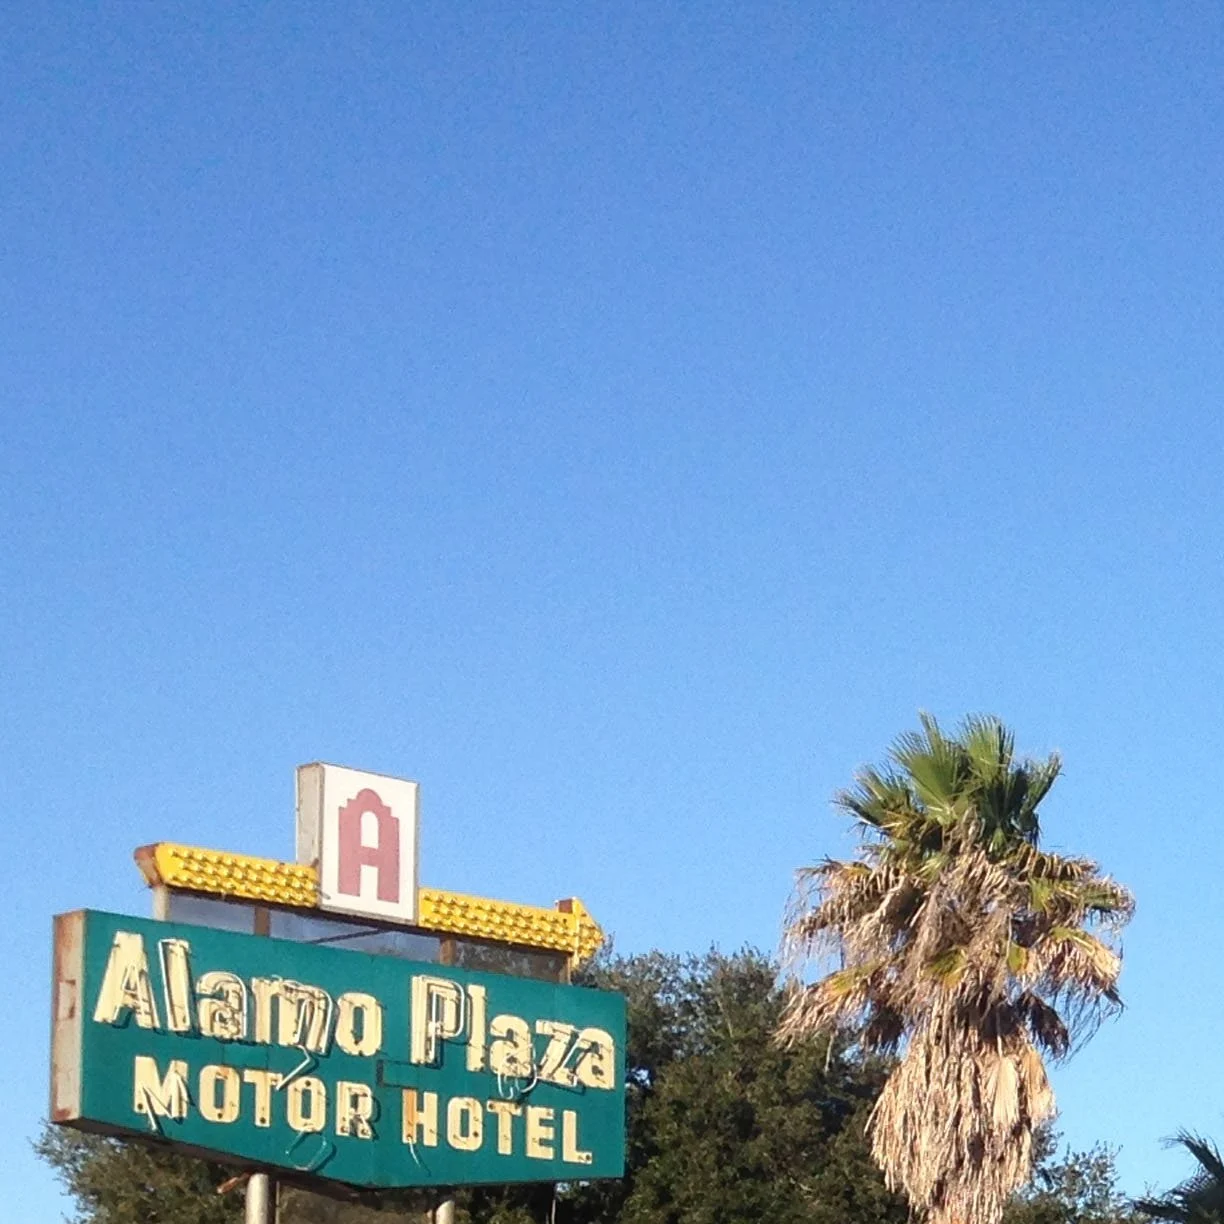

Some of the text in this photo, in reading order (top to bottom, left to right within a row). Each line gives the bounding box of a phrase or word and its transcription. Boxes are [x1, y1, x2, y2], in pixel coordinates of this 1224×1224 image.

[338, 788, 400, 903] A
[93, 930, 615, 1090] Alamo Plaza
[133, 1055, 594, 1165] MOTOR HOTEL
